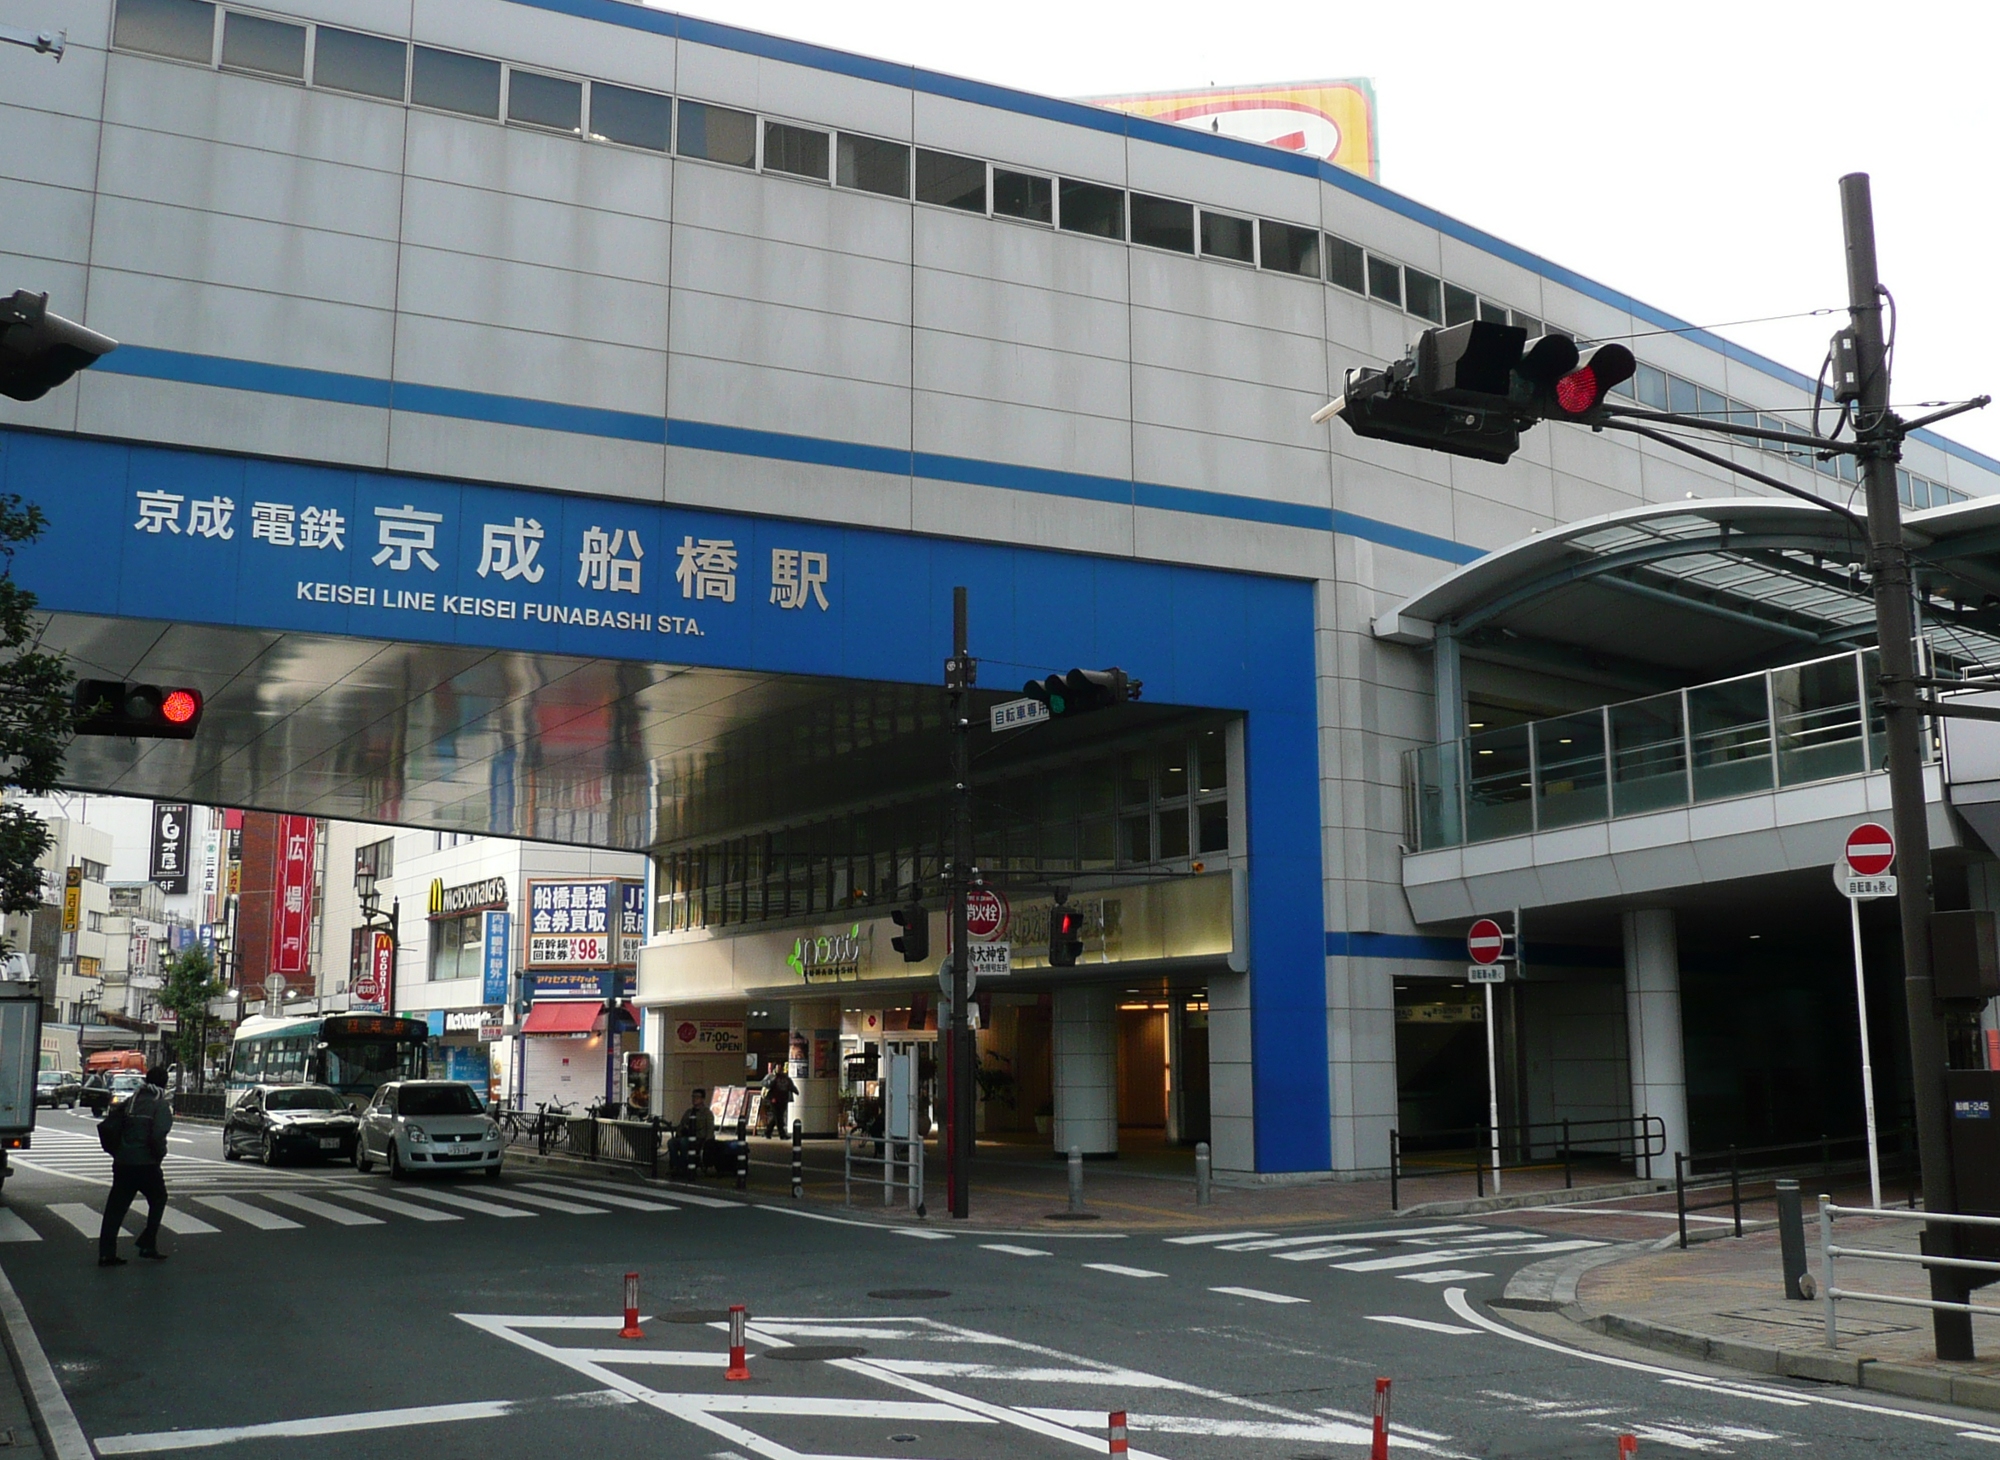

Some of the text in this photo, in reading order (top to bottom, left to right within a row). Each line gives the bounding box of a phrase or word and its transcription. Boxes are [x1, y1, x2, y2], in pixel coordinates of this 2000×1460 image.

[135, 490, 829, 612] 京成電鉄 京成船橋駅
[297, 581, 705, 636] KEISEI LINE KEISEI FUNABASHI STA.
[443, 876, 505, 911] McDonald's
[534, 886, 606, 909] 船橋最強
[533, 910, 606, 932] 金券買取
[533, 939, 568, 949] 新幹線
[533, 950, 568, 960] 回数券
[715, 1043, 743, 1051] OPEN!
